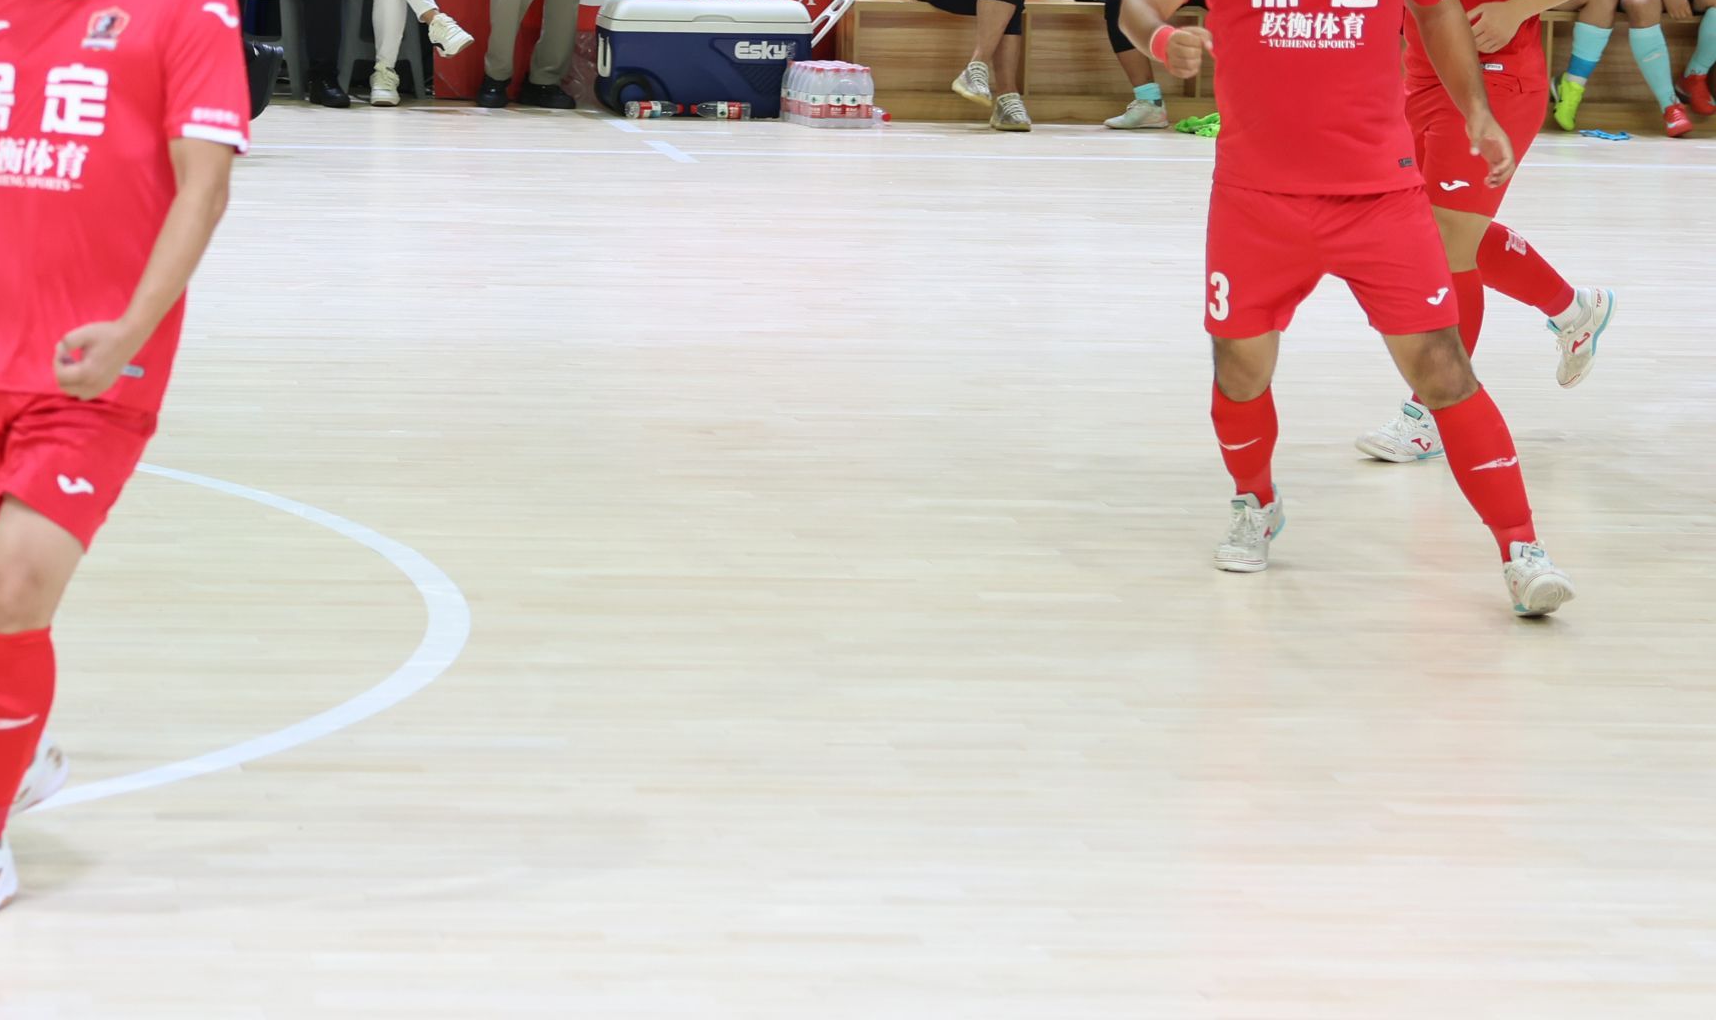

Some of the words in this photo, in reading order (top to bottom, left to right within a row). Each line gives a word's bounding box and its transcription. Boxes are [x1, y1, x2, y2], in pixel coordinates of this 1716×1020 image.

[1259, 12, 1365, 40] 跃衡体育
[734, 40, 787, 61] Esky
[1268, 39, 1316, 49] YUEHENG
[1318, 40, 1357, 49] SPORTS
[1209, 271, 1230, 321] 3
